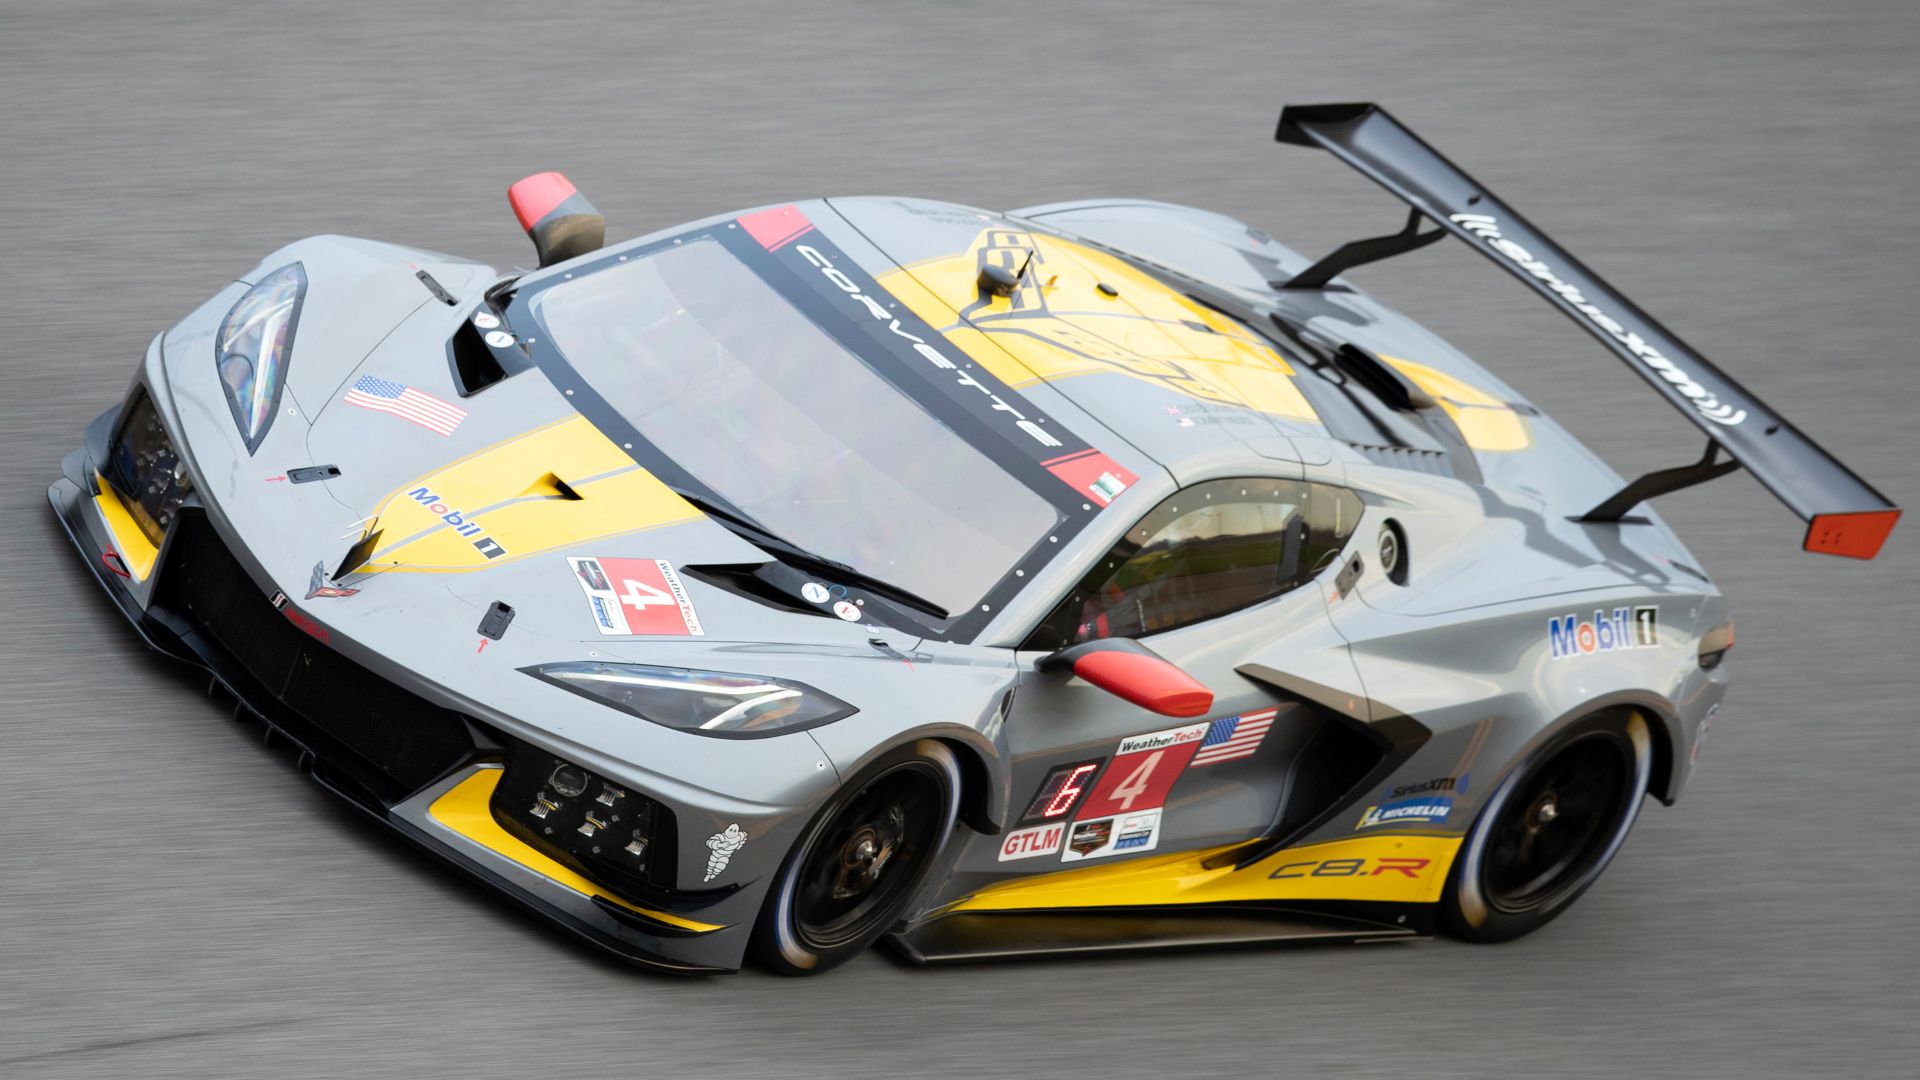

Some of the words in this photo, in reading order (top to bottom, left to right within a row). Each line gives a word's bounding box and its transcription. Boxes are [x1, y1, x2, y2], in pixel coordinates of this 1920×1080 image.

[796, 243, 1064, 448] CORVETTE
[407, 485, 482, 538] Mobil
[619, 578, 676, 611] 4
[659, 561, 699, 633] WeatherTech
[1549, 609, 1632, 660] Mobil
[1121, 729, 1203, 753] WeatherTech
[1108, 750, 1166, 811] 4
[1381, 805, 1451, 820] MICHELIN
[1003, 828, 1063, 856] GTLM
[1268, 858, 1431, 880] C8.R
